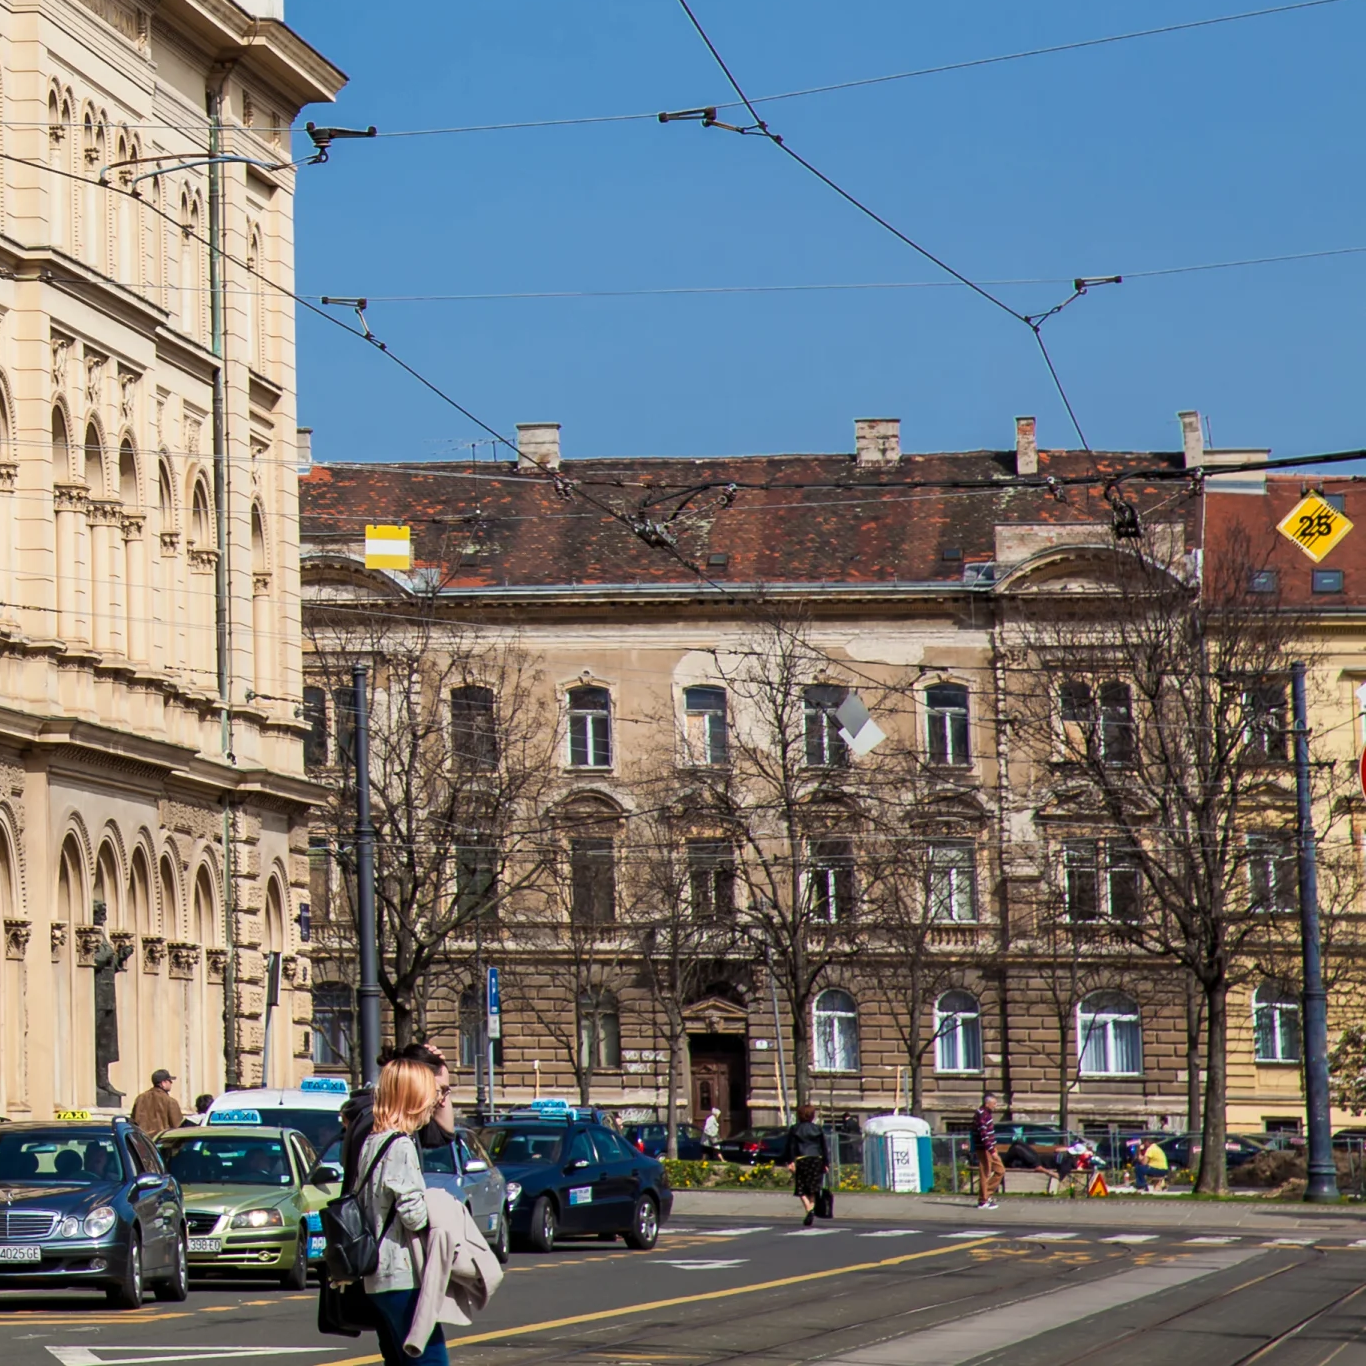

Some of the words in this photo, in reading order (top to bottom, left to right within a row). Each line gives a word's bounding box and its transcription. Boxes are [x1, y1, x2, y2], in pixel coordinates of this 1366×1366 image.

[1299, 514, 1332, 537] 25
[306, 1081, 346, 1091] TAXI
[57, 1111, 88, 1120] TAXI
[217, 1112, 258, 1122] TAXI
[187, 1239, 221, 1251] 398-EO
